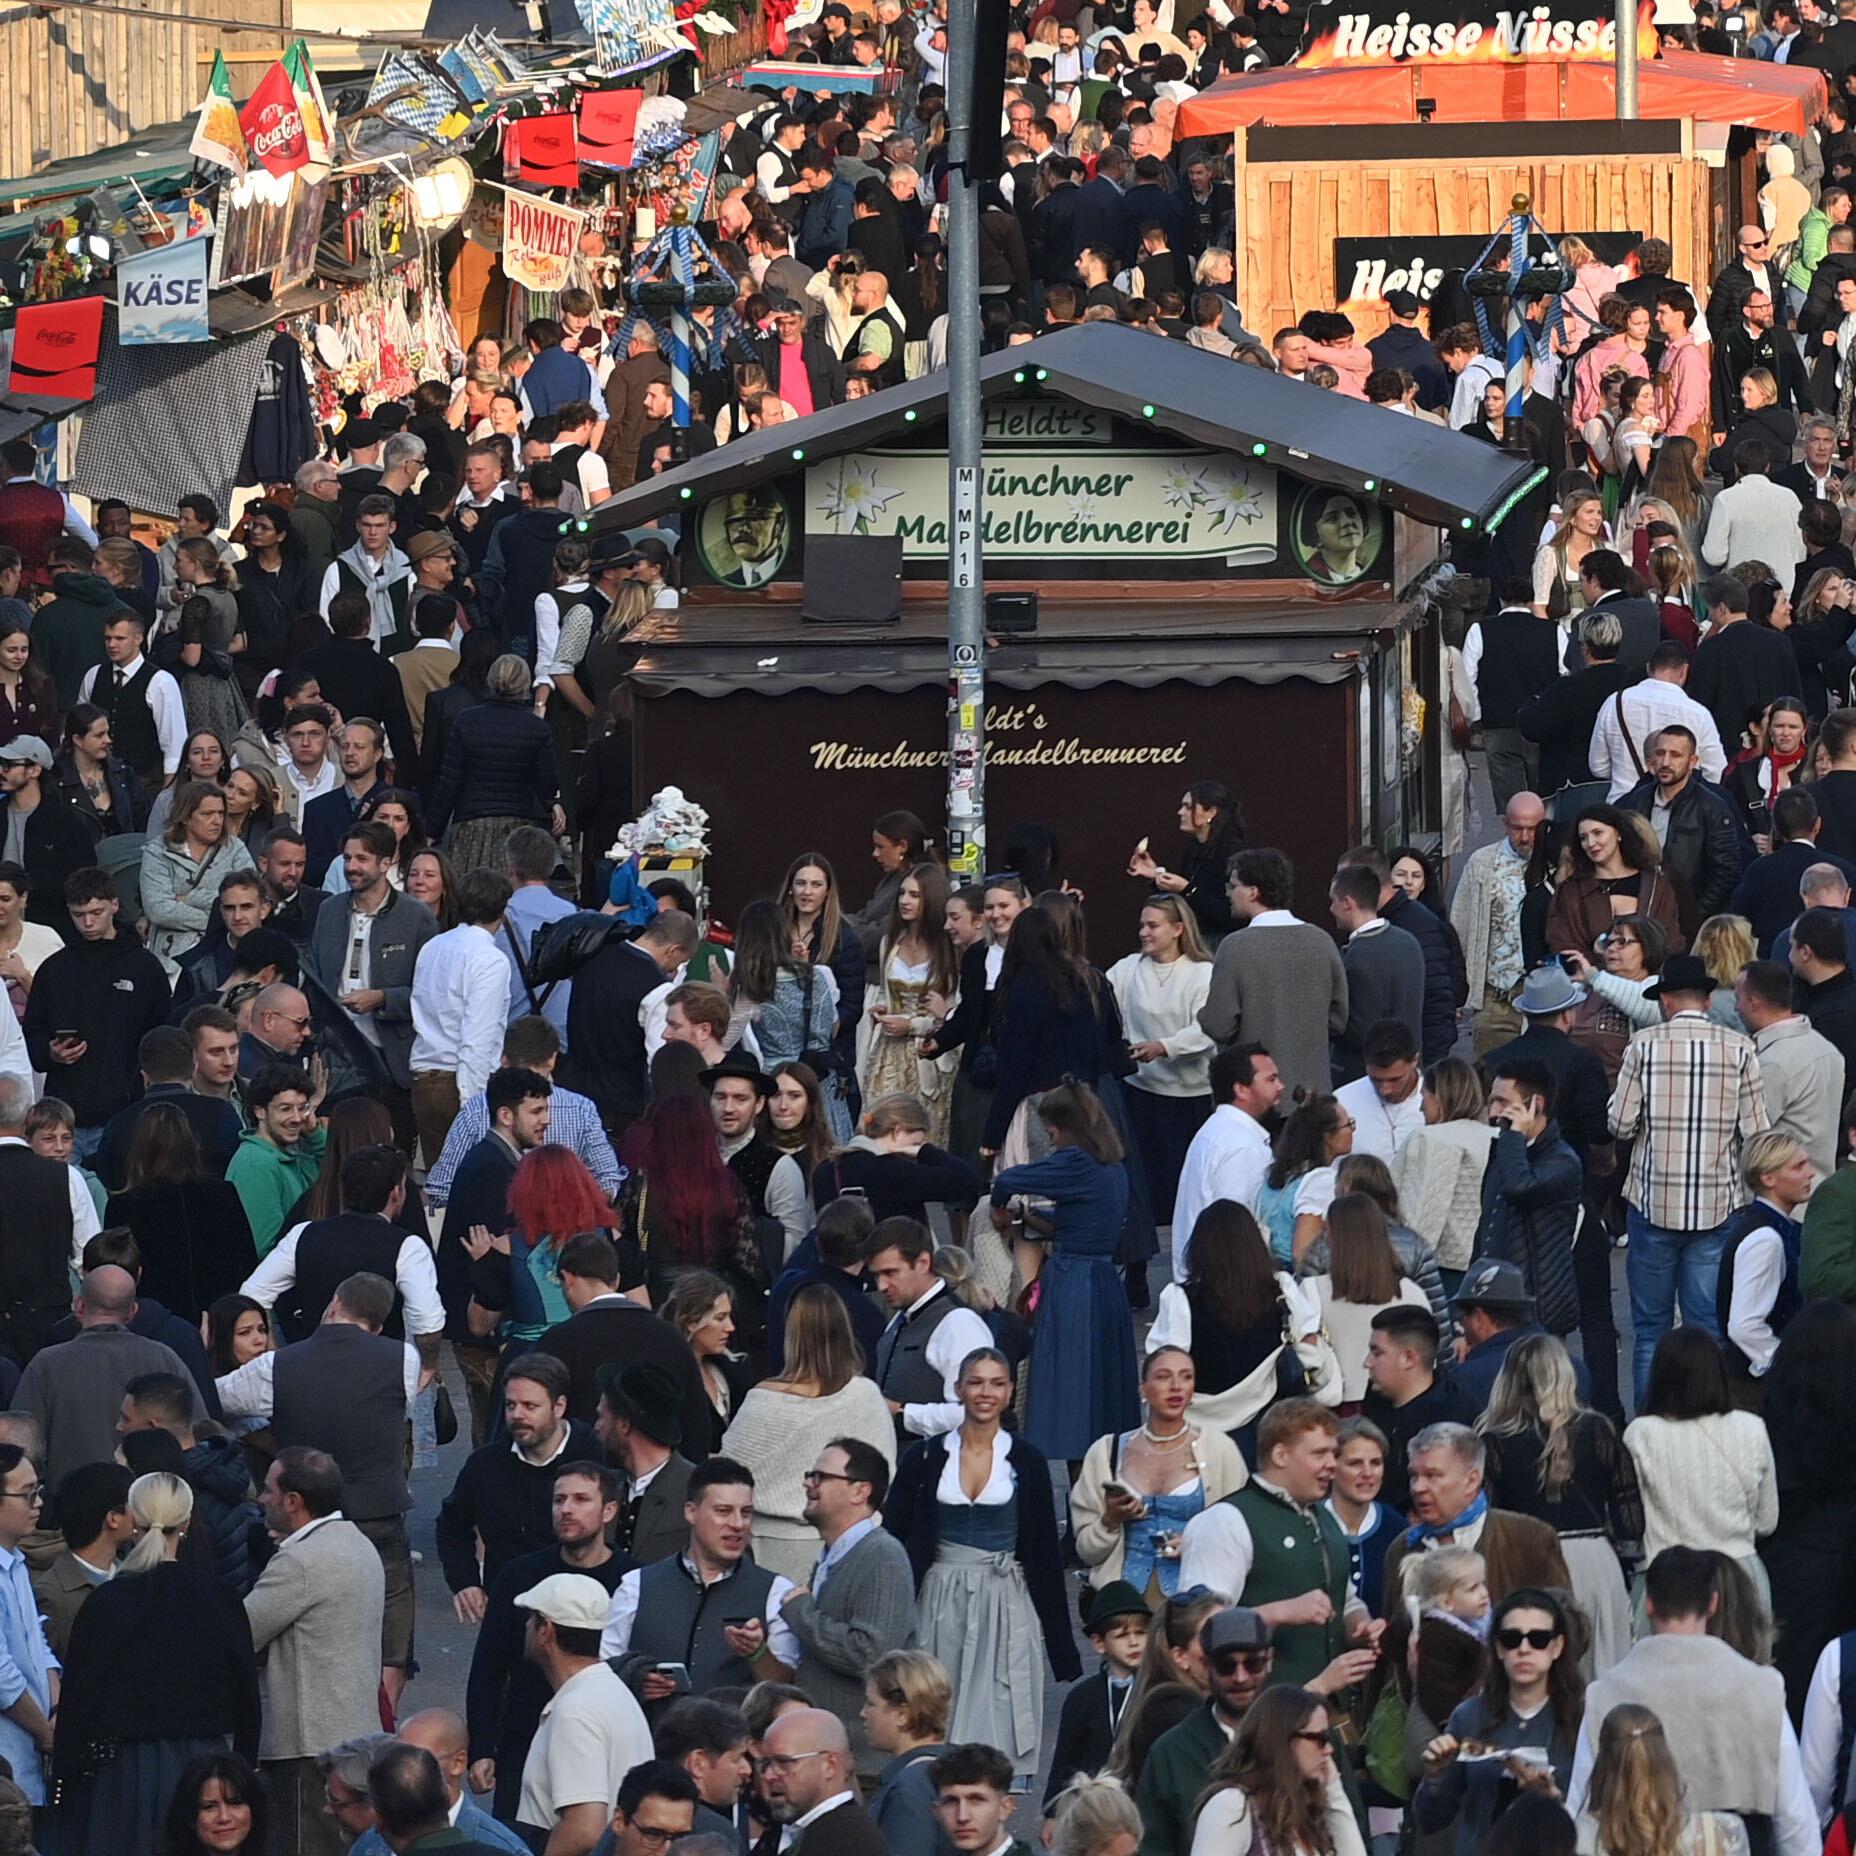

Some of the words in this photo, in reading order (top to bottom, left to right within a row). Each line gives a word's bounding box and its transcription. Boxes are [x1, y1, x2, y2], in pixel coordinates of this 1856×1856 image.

[1333, 11, 1483, 60] Heisse
[1490, 5, 1616, 57] Nüsse
[509, 199, 577, 260] POMMES
[124, 273, 204, 308] KÄSE
[982, 465, 1134, 497] ünchner
[895, 511, 1194, 546] Madelbrennerei
[983, 704, 1048, 731] ldt's
[810, 741, 951, 770] Münchner
